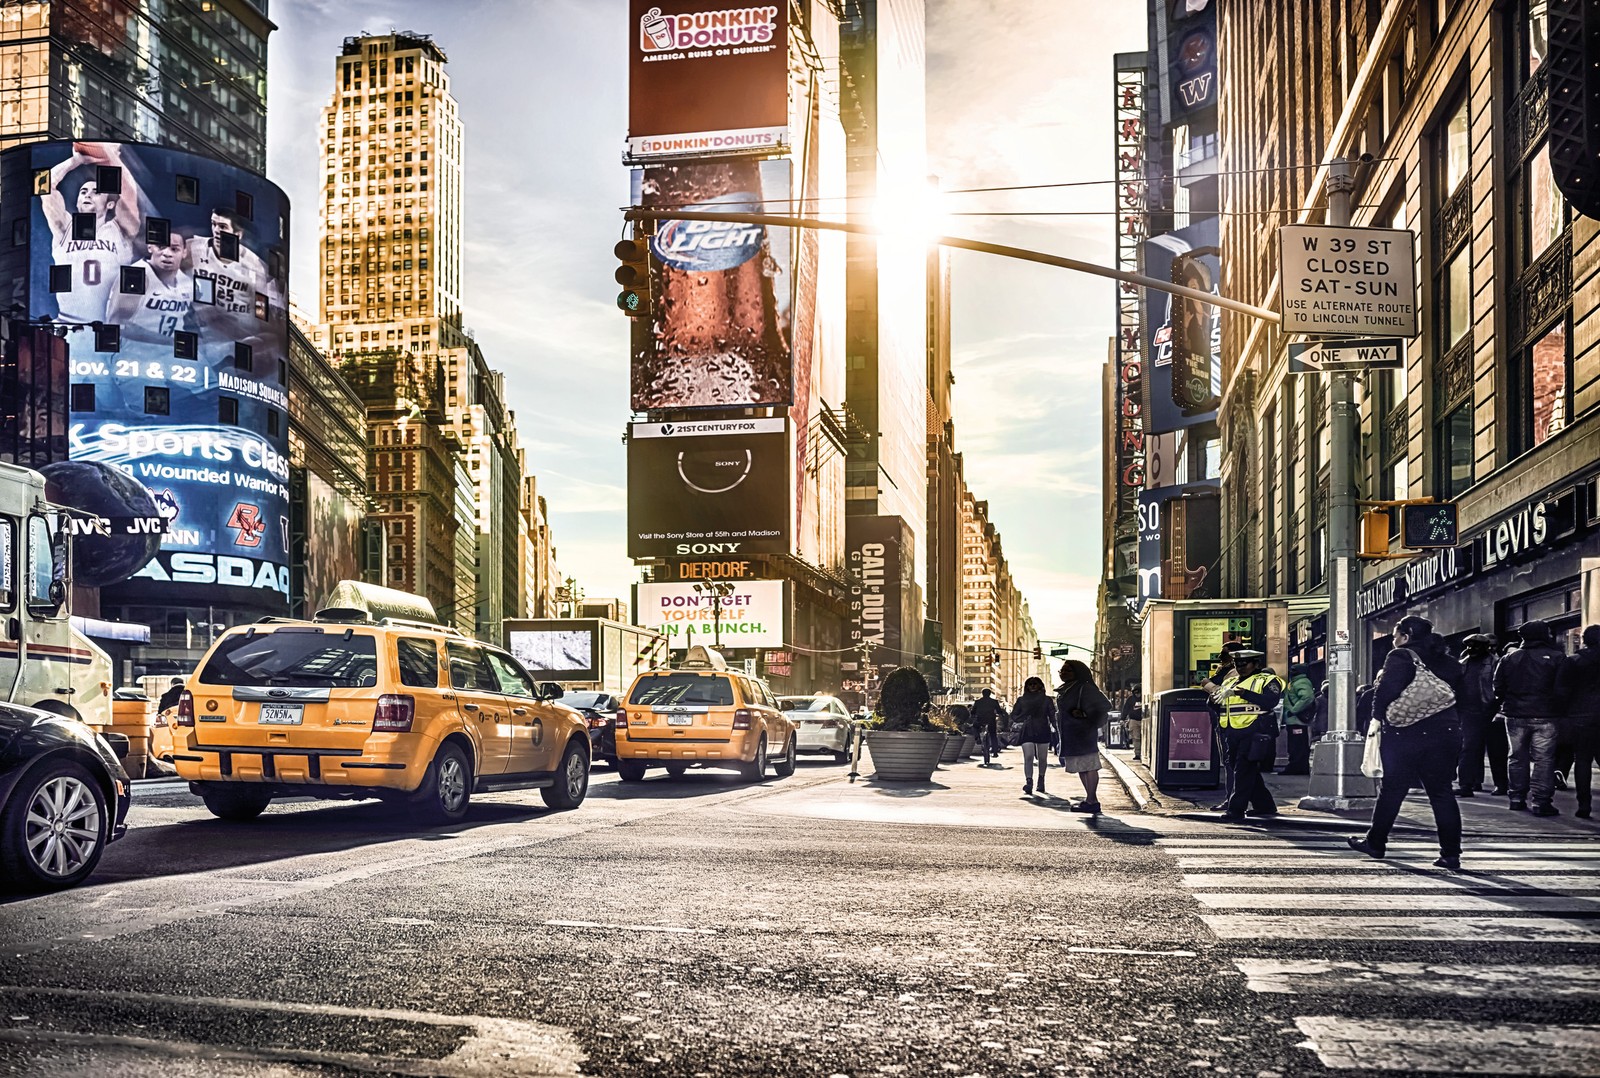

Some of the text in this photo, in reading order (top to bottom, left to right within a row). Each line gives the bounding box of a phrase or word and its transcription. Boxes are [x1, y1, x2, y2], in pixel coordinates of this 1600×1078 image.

[677, 8, 776, 31] DUNKIN'
[677, 25, 770, 47] DONUTS
[643, 53, 686, 63] AMERICA
[688, 49, 713, 59] RUNS
[715, 48, 731, 57] ON
[1180, 72, 1212, 106] W
[66, 239, 118, 255] INDIANA
[670, 228, 762, 253] LIGHT
[1303, 236, 1392, 255] W 39 ST
[1306, 258, 1390, 276] CLOSED
[1300, 278, 1398, 297] SAT-SUN
[1286, 300, 1412, 314] USE ALTERNATE ROUTE
[1294, 312, 1406, 327] TO LINCOLN TUNNEL
[1310, 347, 1391, 362] ONE WAY
[115, 360, 139, 377] 21
[146, 362, 165, 379] &
[171, 365, 196, 383] 22
[218, 371, 258, 395] MADISON
[676, 422, 756, 433] 21ST CENTURY FOX
[99, 423, 233, 461] Sports
[139, 462, 231, 486] Wounded
[234, 472, 278, 495] Warrior
[64, 517, 161, 536] JVC JVC
[666, 532, 685, 540] Sony
[748, 529, 781, 537] Madison
[676, 542, 741, 555] SONY
[862, 543, 885, 589] CALL
[1375, 576, 1396, 610] GUMP
[1405, 556, 1439, 598] SHRIMP
[661, 595, 752, 607] DON'T GET
[662, 609, 745, 621] YOURSELF
[862, 593, 885, 645] DUTY
[661, 624, 679, 635] IN
[686, 624, 697, 634] A
